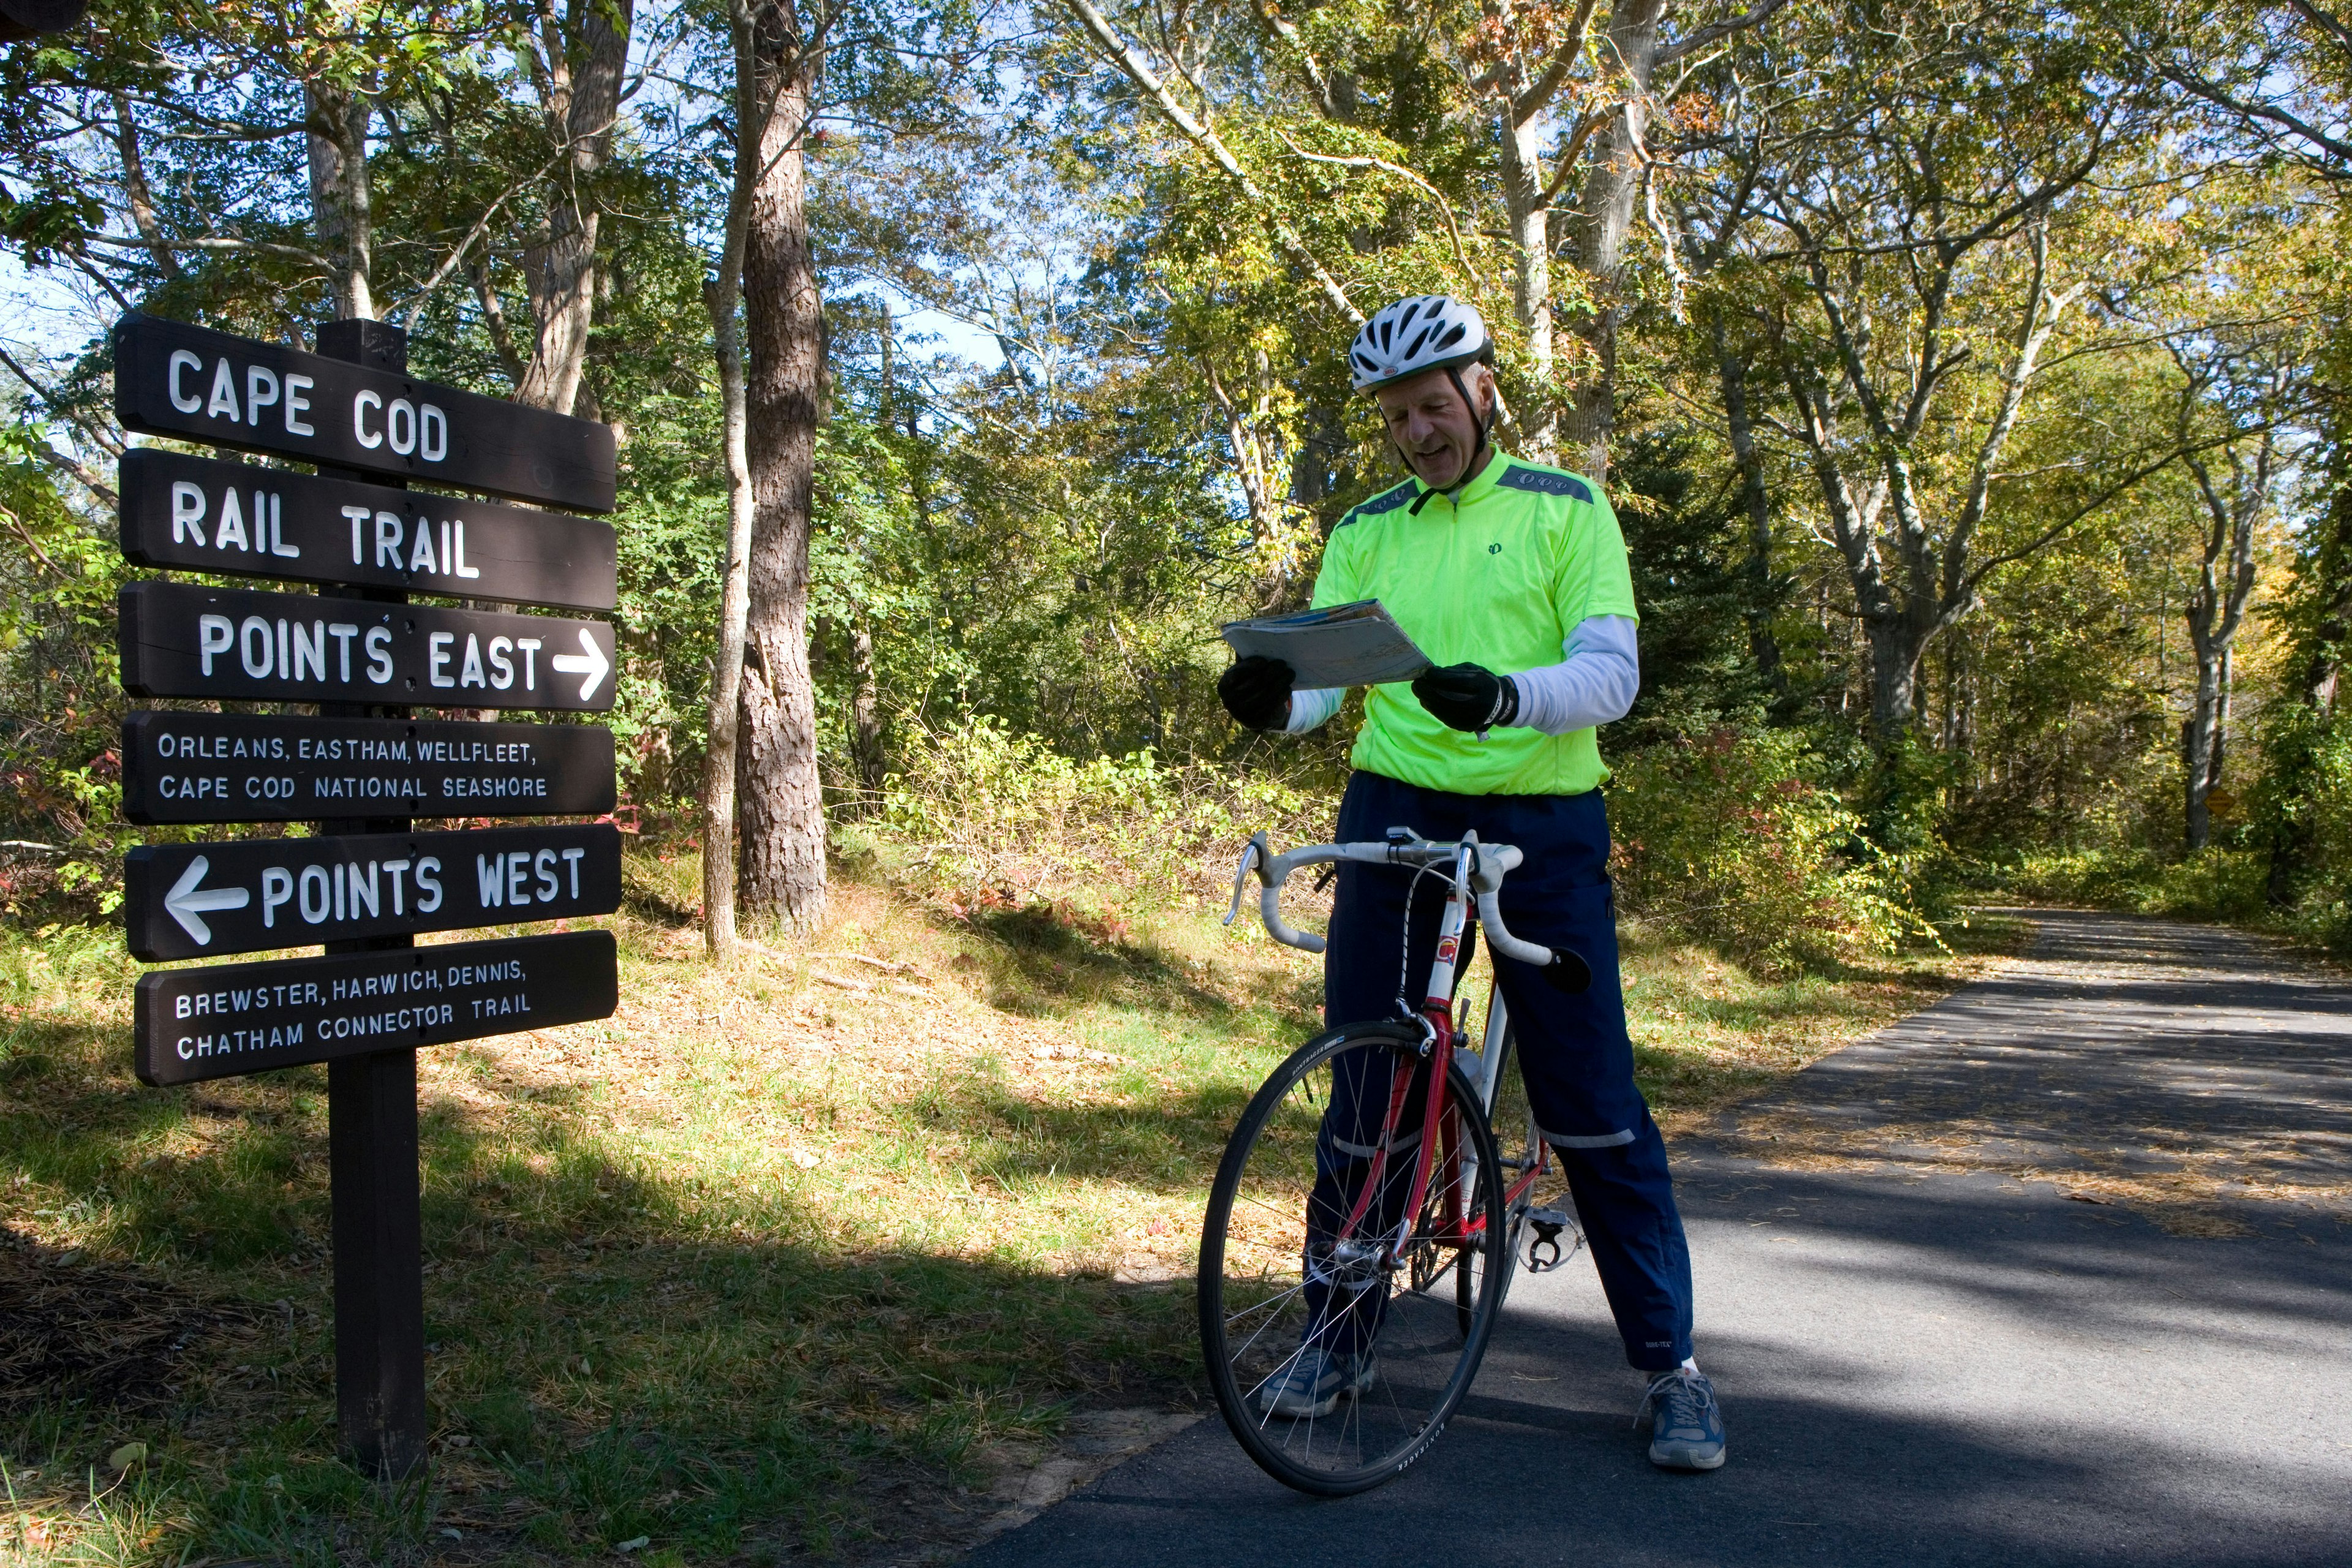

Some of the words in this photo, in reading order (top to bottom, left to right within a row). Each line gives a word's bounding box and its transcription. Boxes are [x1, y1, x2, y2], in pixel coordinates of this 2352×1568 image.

[169, 350, 315, 437] CAPE
[353, 389, 447, 462] COD
[172, 481, 300, 558] RAIL
[341, 505, 480, 579] TRAIL
[200, 614, 393, 684] POINTS
[429, 631, 542, 691] EAST
[158, 733, 290, 761] ORLEANS,
[299, 739, 411, 764] EASTHAM,
[417, 741, 536, 766] WELLFLEET,
[159, 775, 228, 799] CAPE
[246, 777, 295, 798] COD
[315, 777, 427, 797] NATIONAL
[443, 777, 547, 797] SEASHORE
[262, 856, 443, 928] POINTS
[477, 848, 585, 908] WEST
[176, 982, 326, 1019] BREWSTER,
[333, 970, 443, 1001] HARWICH,
[448, 960, 526, 986] DENNIS,
[177, 1023, 303, 1060] CHATHAM
[318, 1005, 453, 1039] CONNECTOR
[472, 993, 530, 1019] TRAIL
[1292, 1046, 1324, 1076] BONTRAGER
[1398, 1423, 1444, 1471] BONTRAGER
